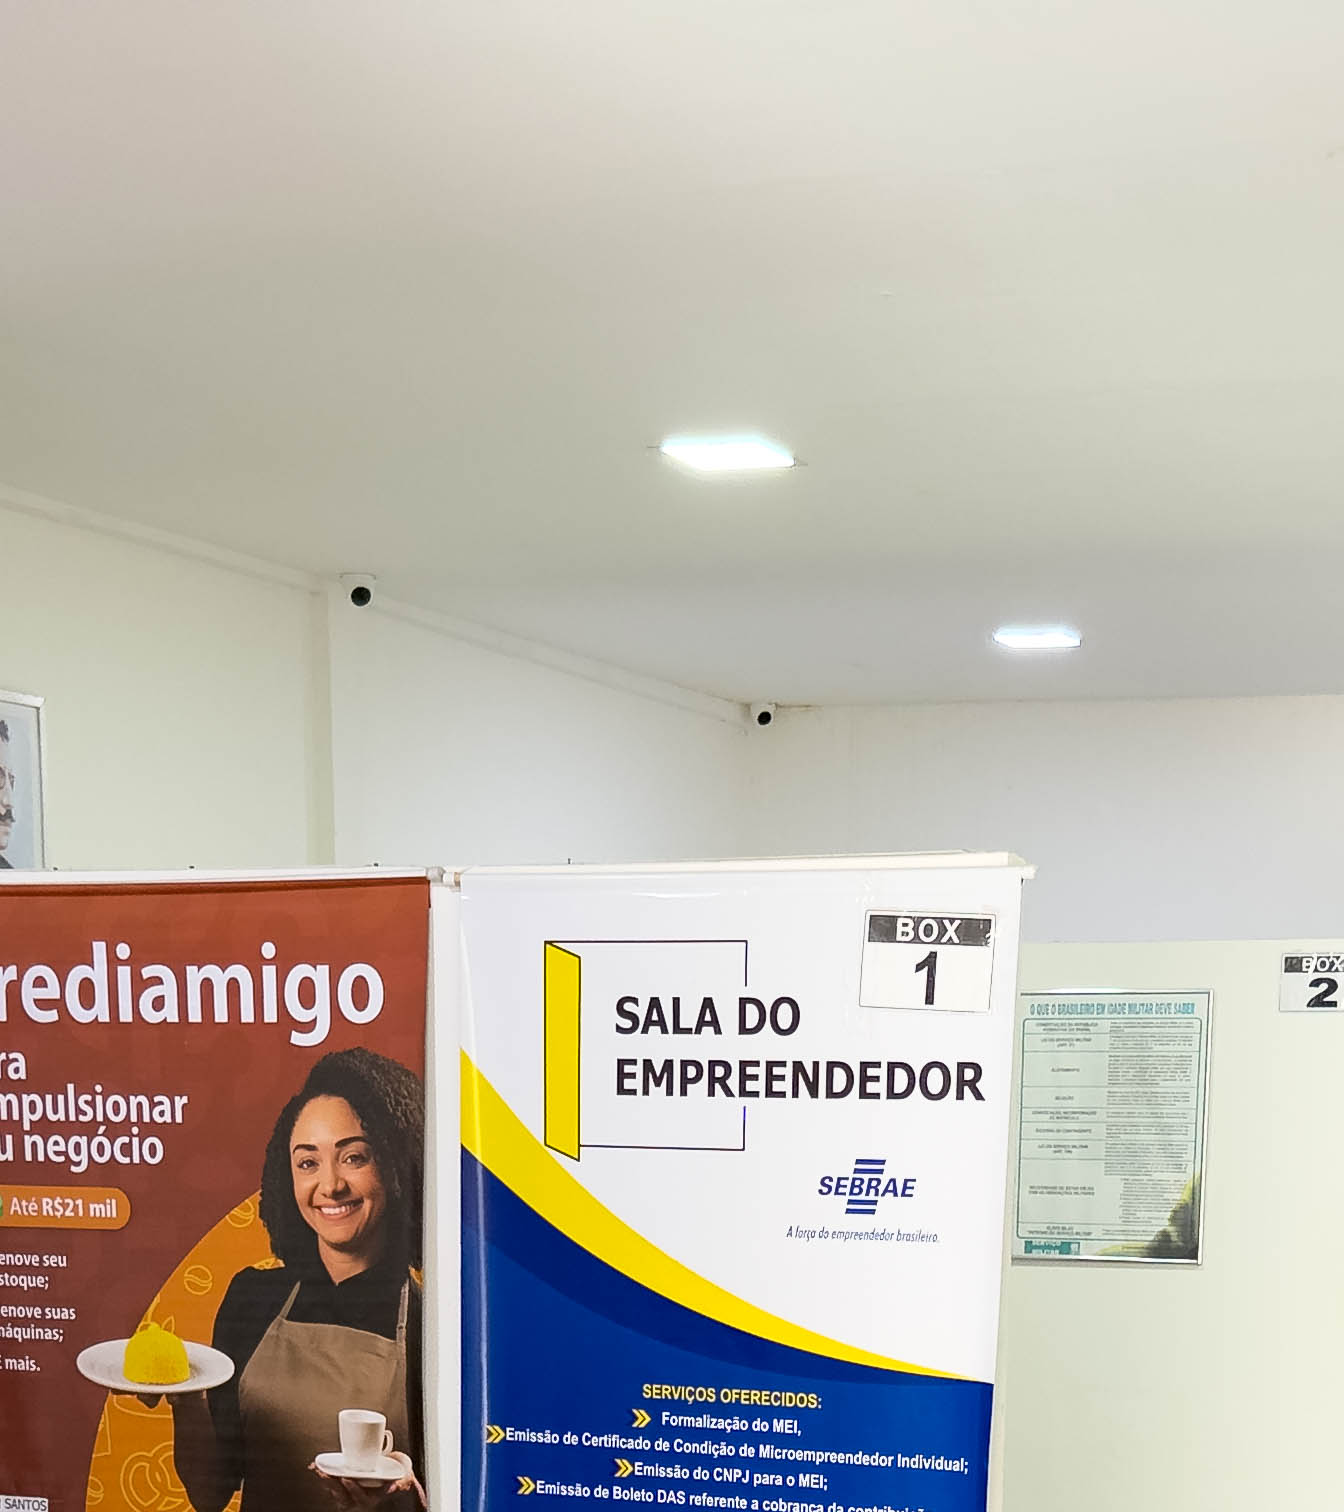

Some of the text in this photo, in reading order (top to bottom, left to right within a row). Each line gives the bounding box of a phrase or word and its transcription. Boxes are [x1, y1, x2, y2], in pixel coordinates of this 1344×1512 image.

[895, 917, 962, 944] BOX
[1301, 956, 1344, 972] BOX
[914, 950, 939, 1005] 1
[1306, 977, 1339, 1008] 2
[616, 996, 800, 1036] SALA DO
[616, 1058, 985, 1101] EMPREENDEDOR
[24, 1125, 165, 1173] negócio
[818, 1175, 917, 1198] SEBRAE
[10, 1197, 117, 1219] Até R$21 mil
[786, 1226, 794, 1237] A
[819, 1226, 830, 1240] do
[831, 1228, 895, 1242] empreendedor
[42, 1254, 67, 1268] seu
[45, 1307, 77, 1320] suas
[5, 1356, 41, 1371] mais.
[642, 1384, 822, 1409] SERVIÇOS OFERECIDOS:
[661, 1411, 802, 1436] Formalização do MEI,
[505, 1427, 969, 1474] Emissão de Certificado de Condição de Microempreendedor Individual;
[634, 1461, 828, 1491] Emissão do CNPJ para o MEI;
[4, 1498, 47, 1511] SANTOS
[536, 1480, 590, 1497] Emissão
[594, 1485, 609, 1499] de
[612, 1486, 654, 1502] Boleto
[657, 1489, 686, 1504] DAS
[689, 1492, 747, 1510] referente
[750, 1499, 759, 1510] a
